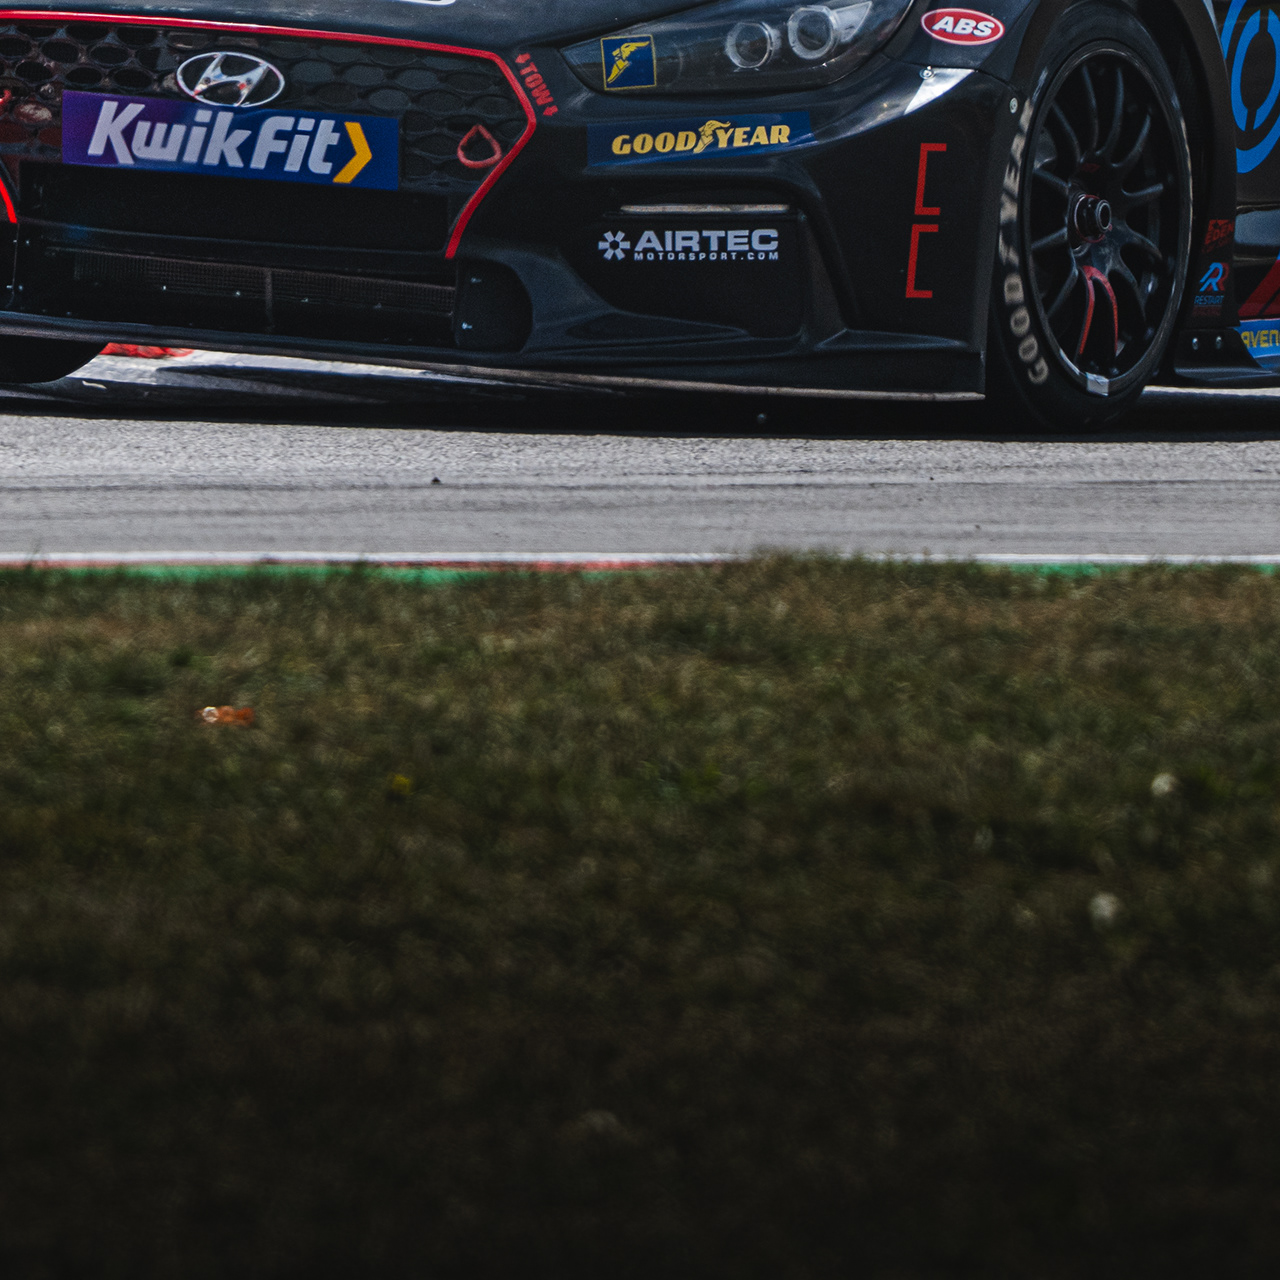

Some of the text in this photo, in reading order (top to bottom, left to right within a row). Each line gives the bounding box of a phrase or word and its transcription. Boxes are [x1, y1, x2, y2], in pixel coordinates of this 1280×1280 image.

[932, 14, 996, 39] ABS
[519, 61, 554, 107] TOW
[611, 121, 791, 155] GOODYEAR
[634, 228, 779, 252] AIRTEC
[998, 97, 1049, 385] GOODYEAR
[634, 252, 779, 261] MOTORSPORT.COM
[1194, 295, 1225, 306] RESTART
